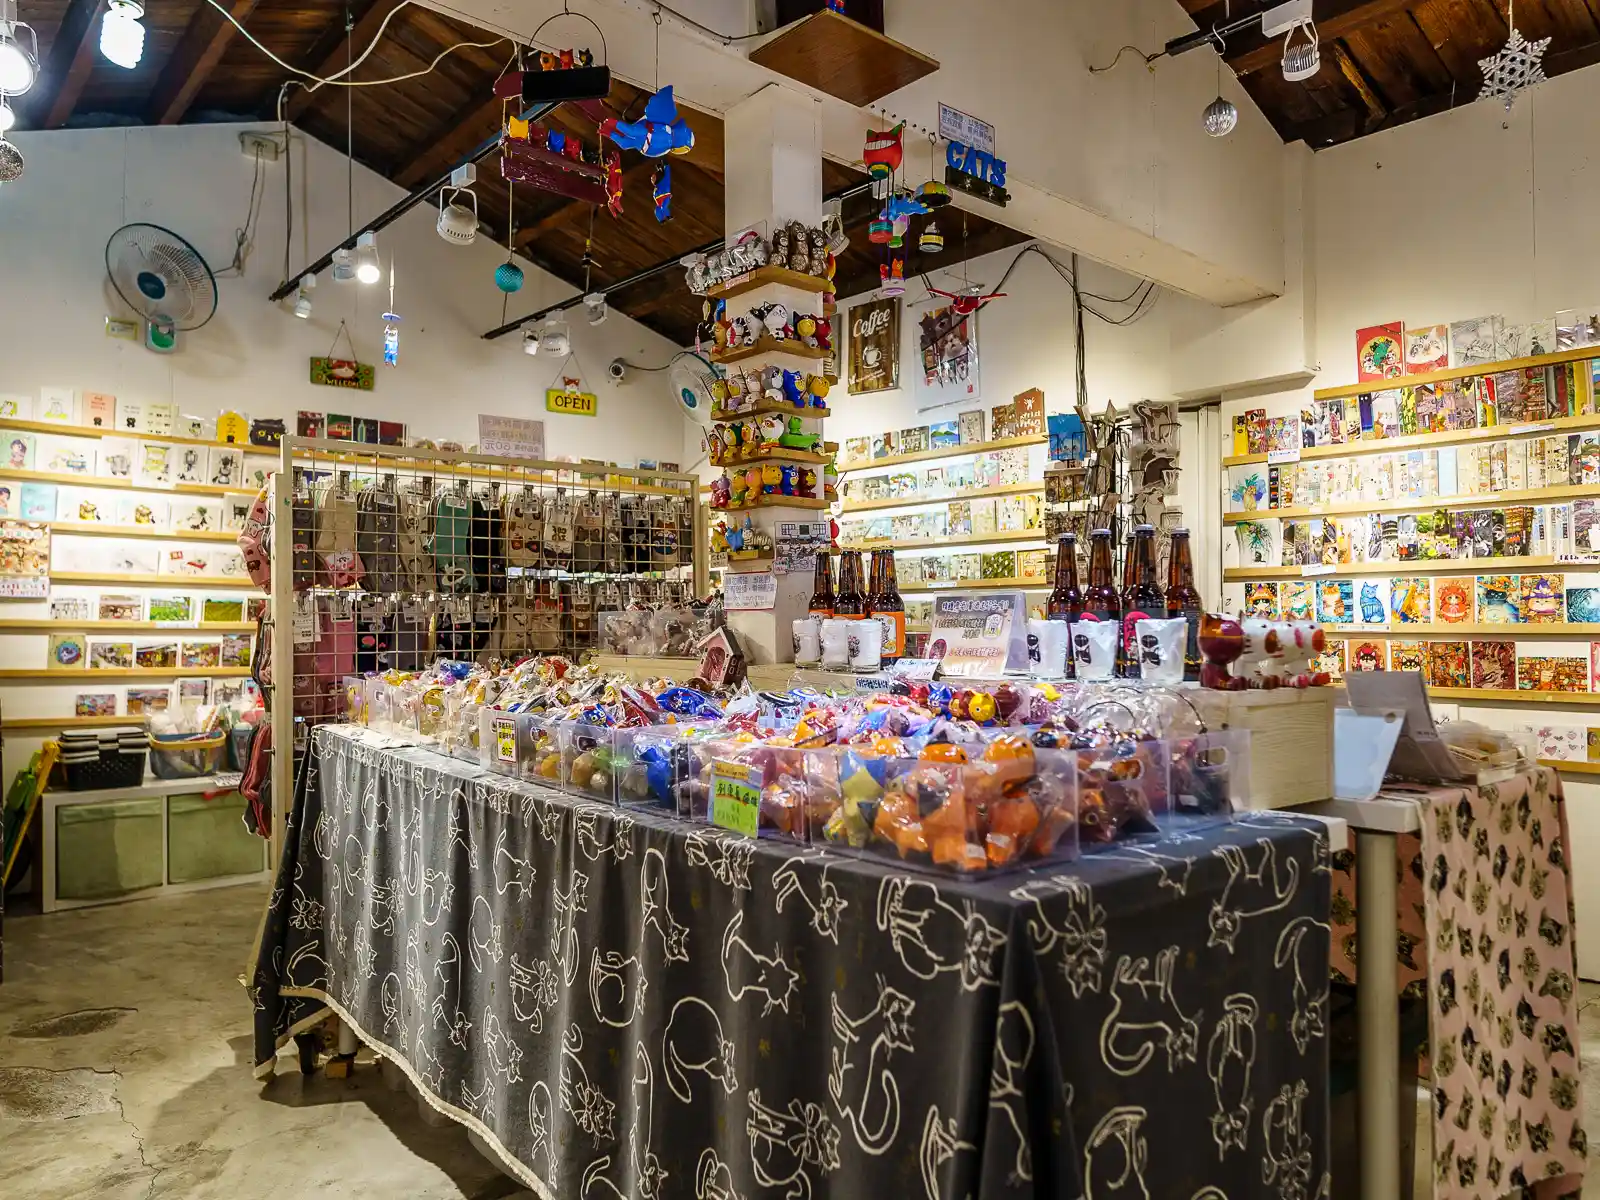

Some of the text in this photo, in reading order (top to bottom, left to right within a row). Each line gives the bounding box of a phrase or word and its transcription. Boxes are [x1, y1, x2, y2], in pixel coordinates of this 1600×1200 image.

[946, 141, 1007, 188] CATS
[853, 308, 891, 337] Coffee
[555, 394, 591, 411] OPEN
